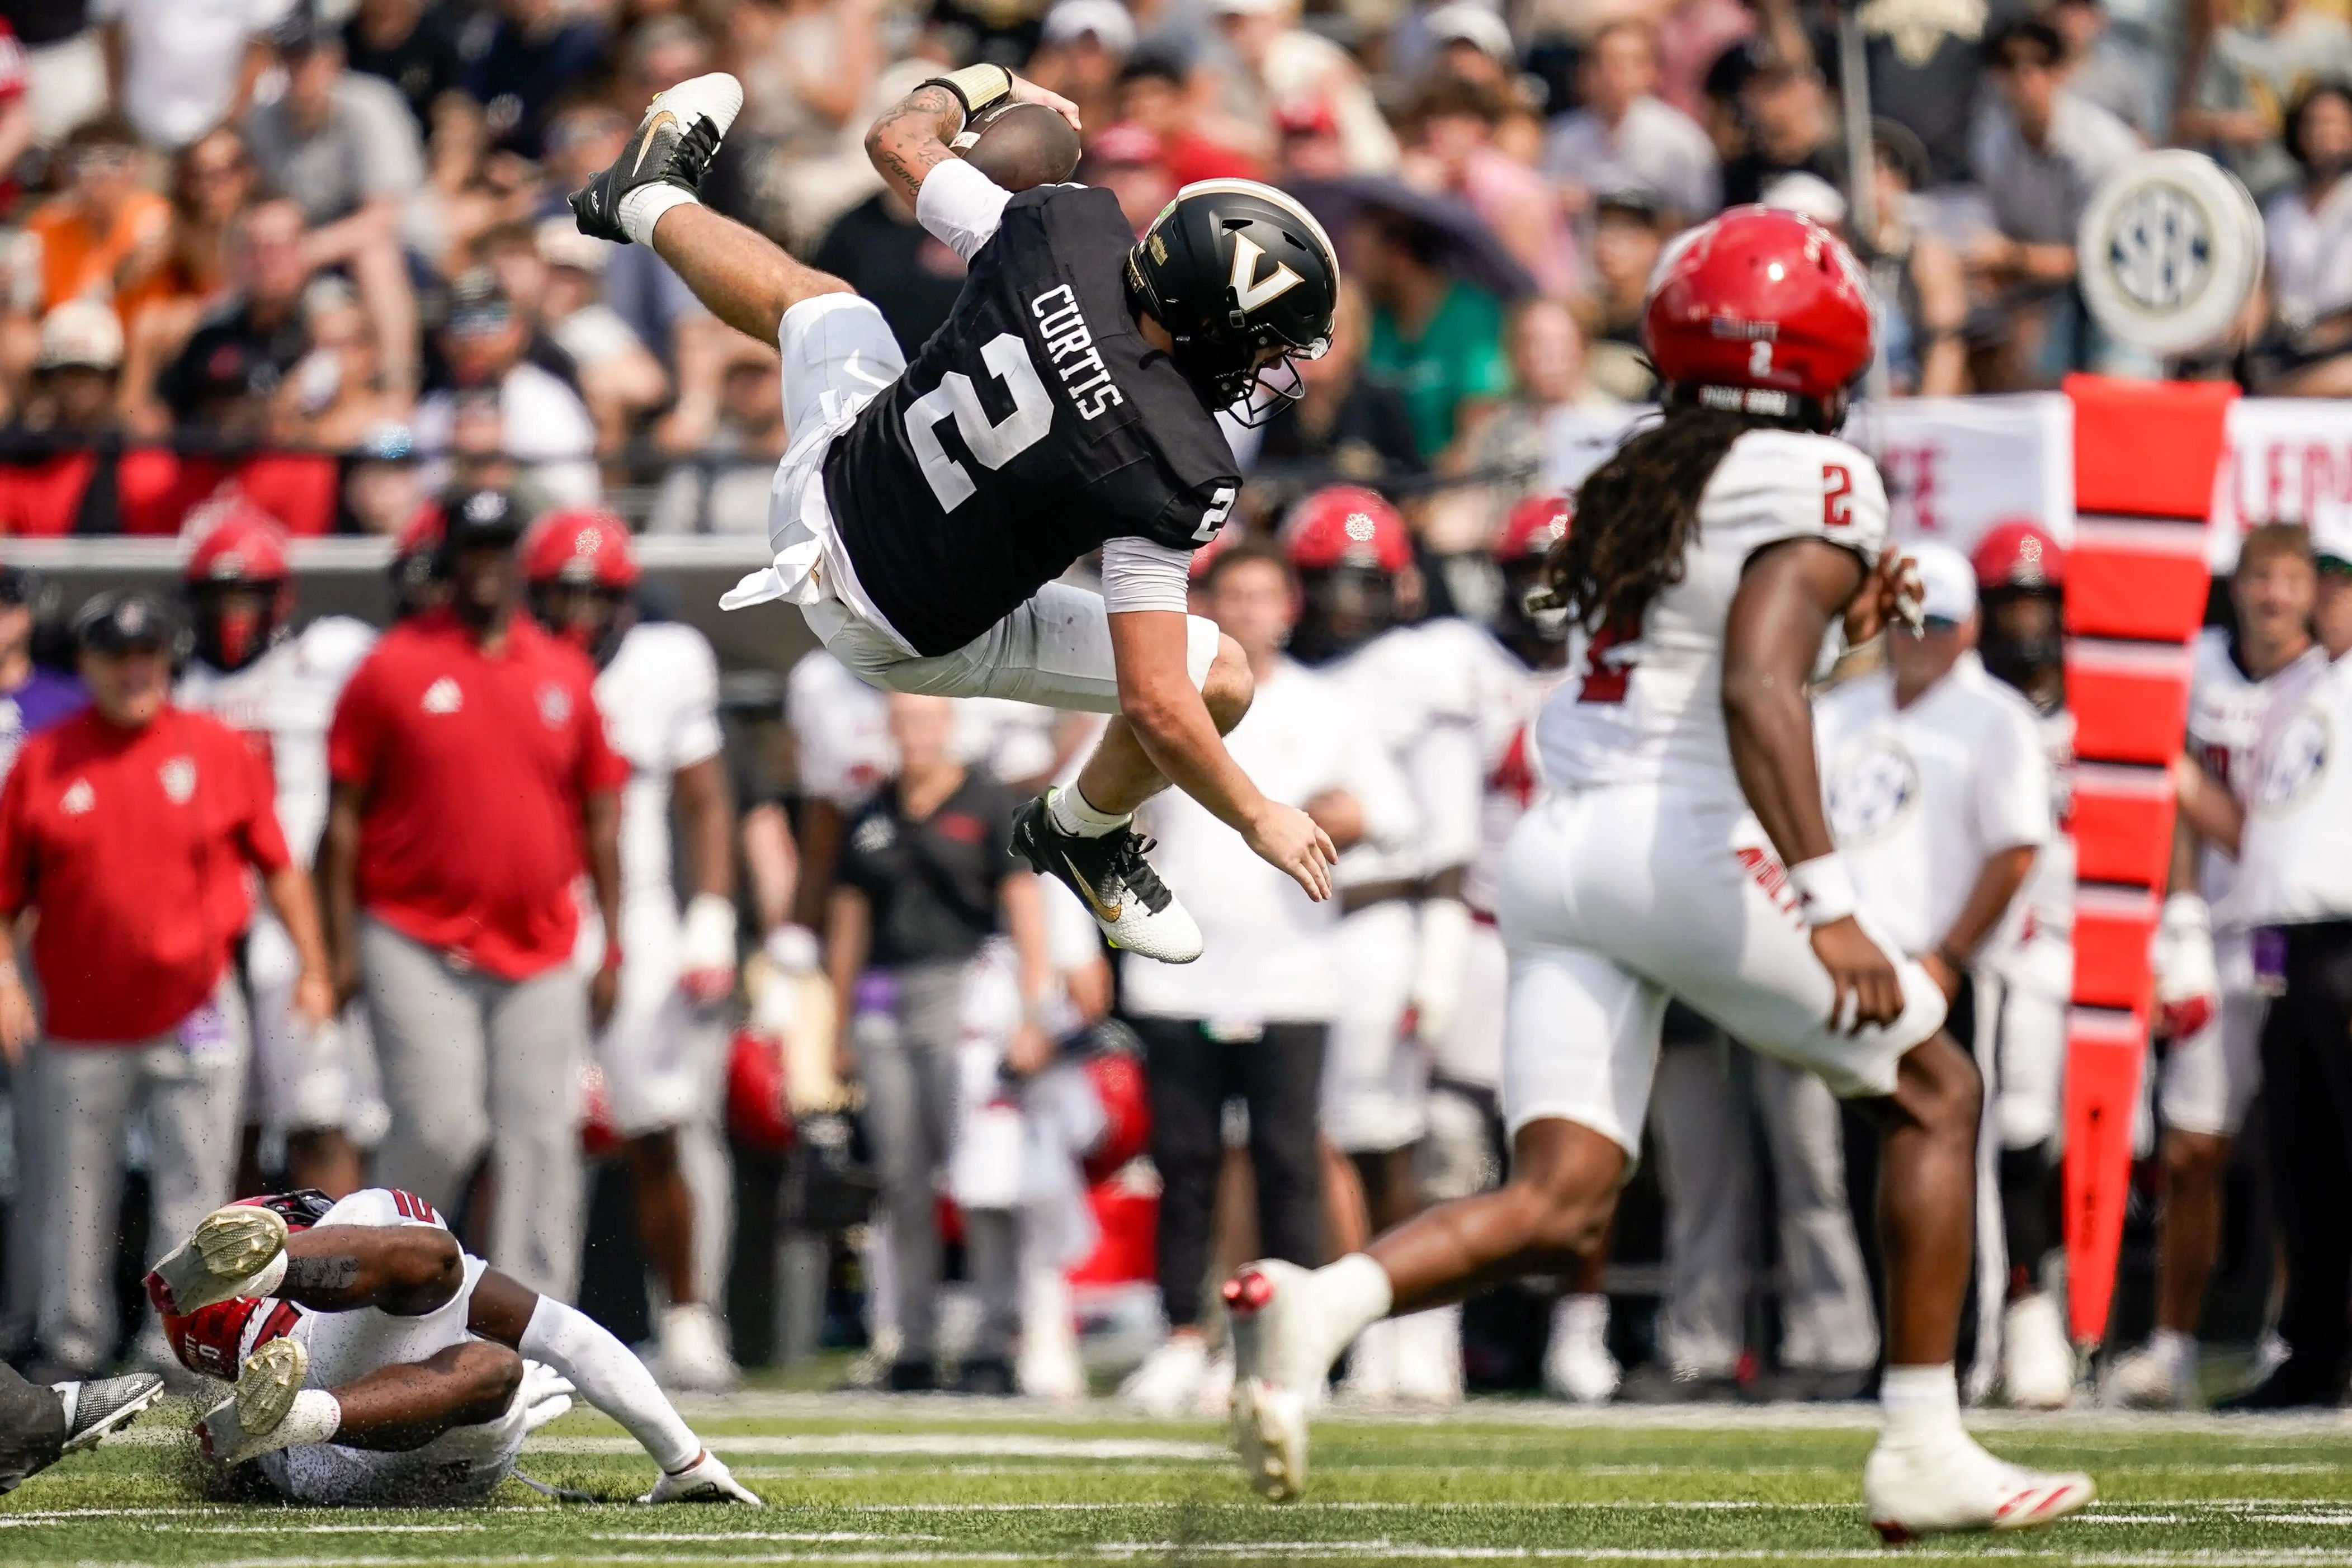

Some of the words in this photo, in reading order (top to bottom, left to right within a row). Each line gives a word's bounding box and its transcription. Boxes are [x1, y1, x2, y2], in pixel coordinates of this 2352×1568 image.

[1031, 284, 1124, 421] CURTIS
[903, 332, 1055, 514] 2
[1191, 487, 1236, 542] 2
[1822, 464, 1852, 526] 2
